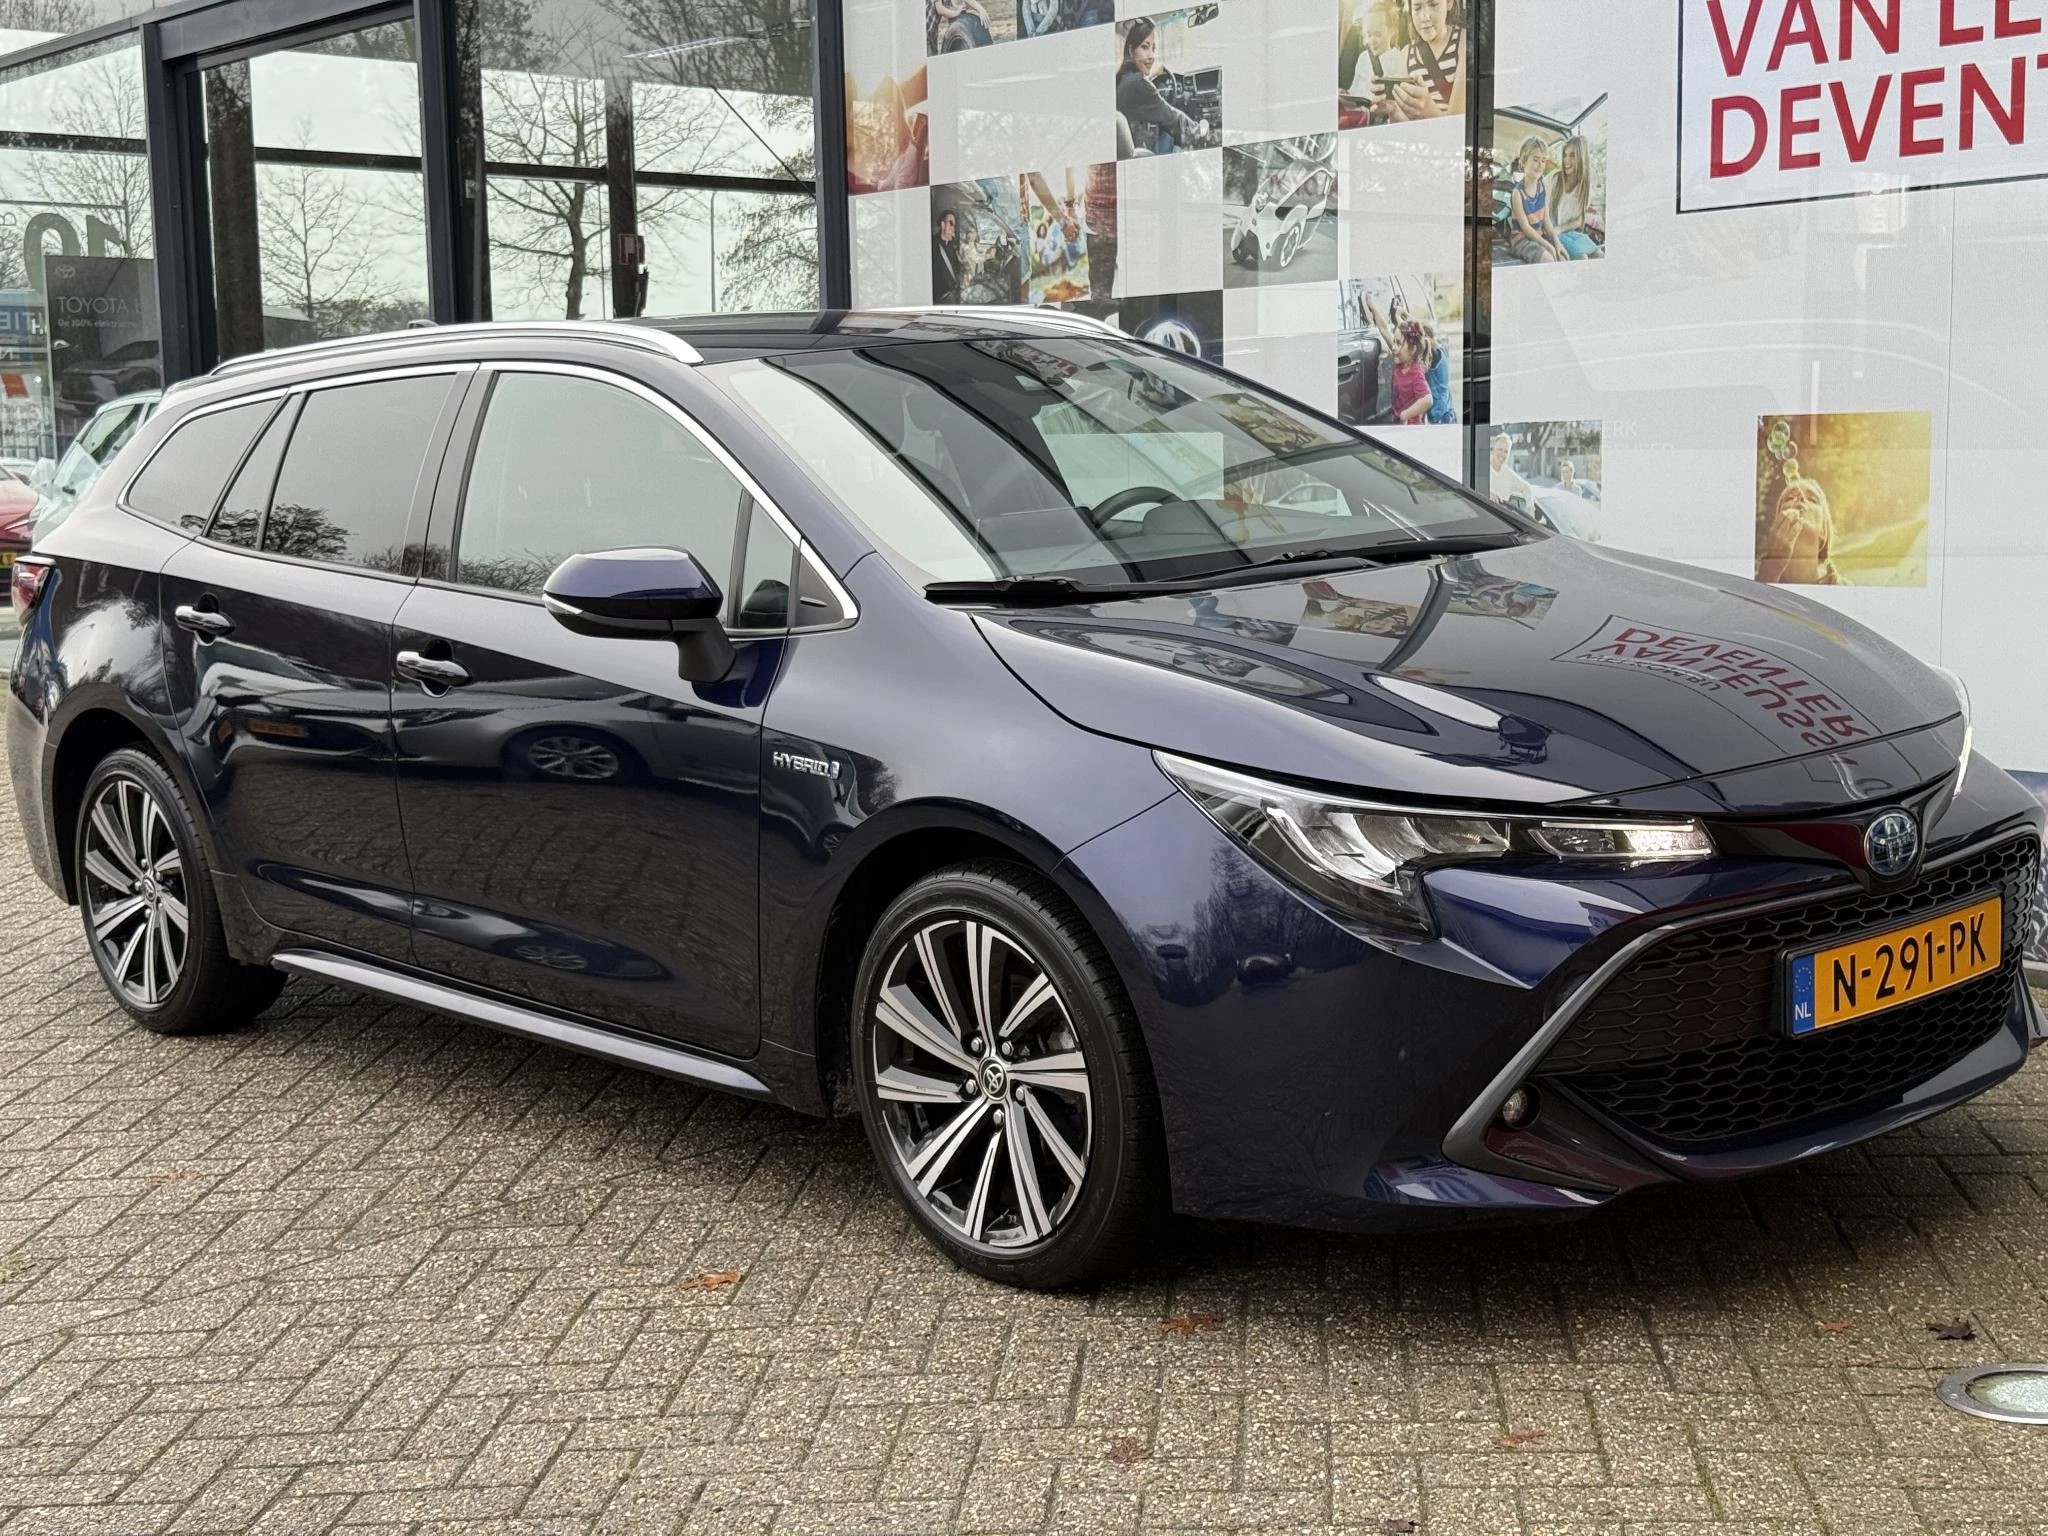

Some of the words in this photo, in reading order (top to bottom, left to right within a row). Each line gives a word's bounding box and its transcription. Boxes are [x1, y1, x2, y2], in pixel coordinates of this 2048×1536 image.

[1707, 0, 1901, 77] VAN
[1709, 54, 2048, 178] DEVEN
[56, 296, 129, 314] TOYOTA
[773, 751, 829, 776] HYBRID
[1833, 912, 1986, 1013] N-291-PK
[1795, 1001, 1812, 1020] NL
